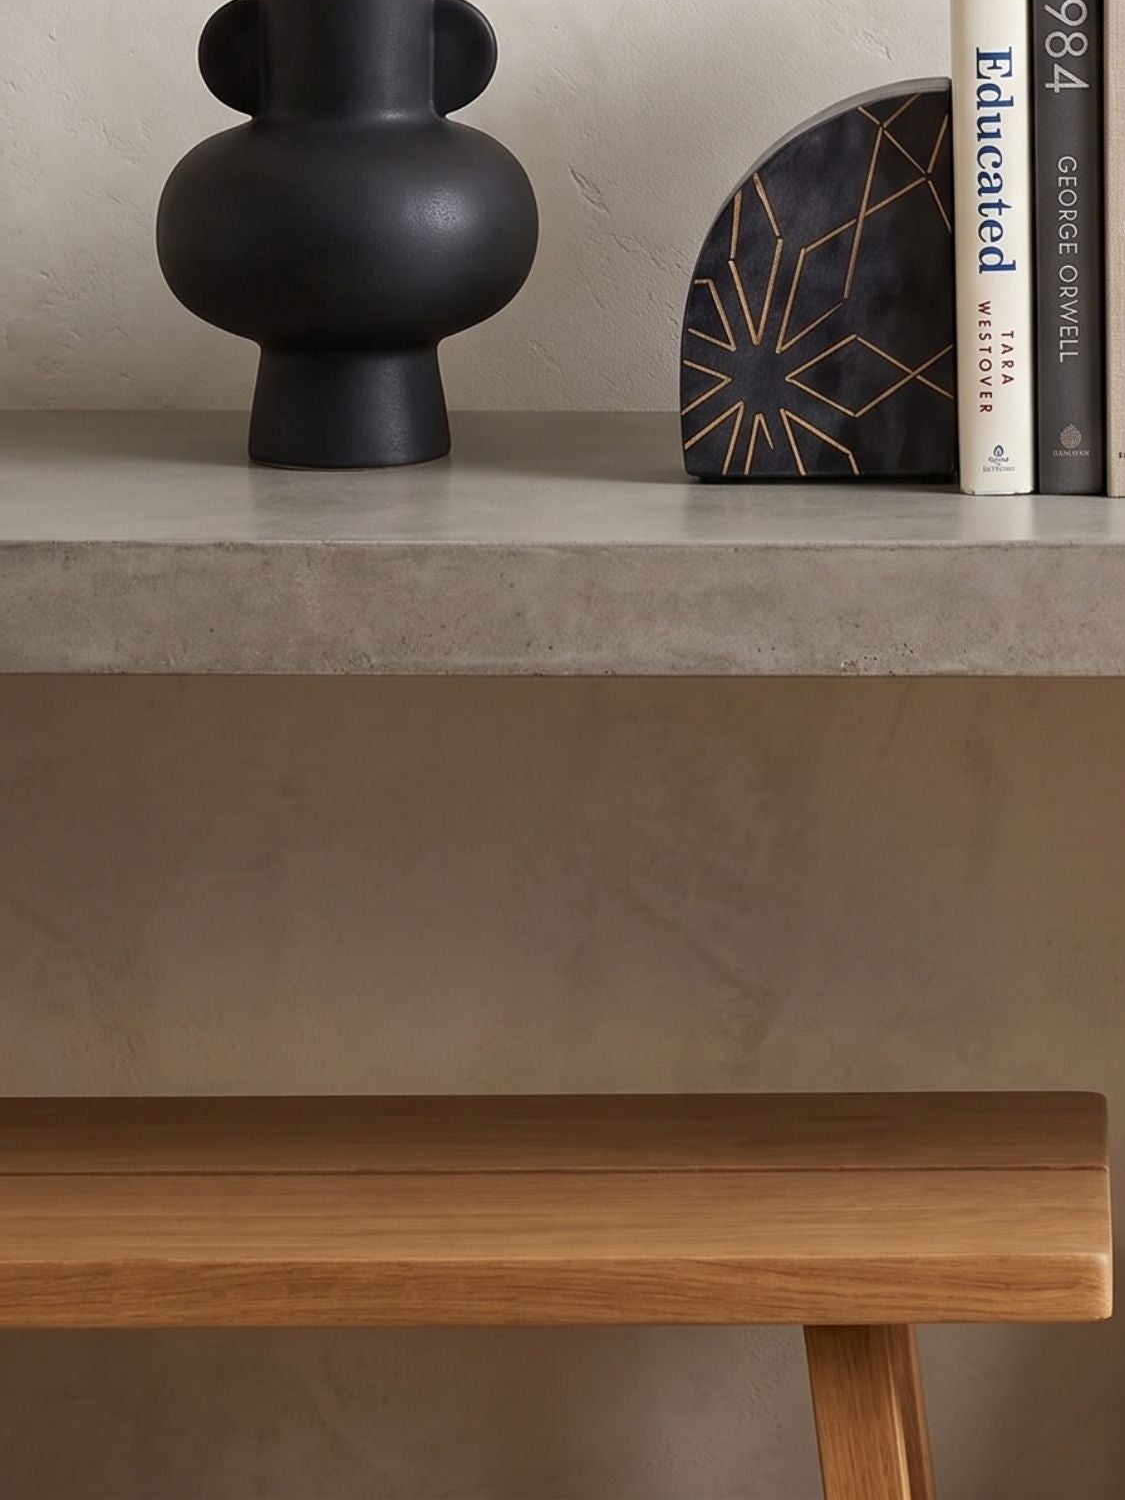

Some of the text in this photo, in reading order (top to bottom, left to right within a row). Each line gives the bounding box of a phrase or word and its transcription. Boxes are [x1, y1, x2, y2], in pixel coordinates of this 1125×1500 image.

[975, 46, 1017, 274] Educated
[1057, 156, 1079, 363] GEORGE ORWELL
[977, 301, 993, 414] WESTOVER
[1001, 330, 1015, 385] TARA
